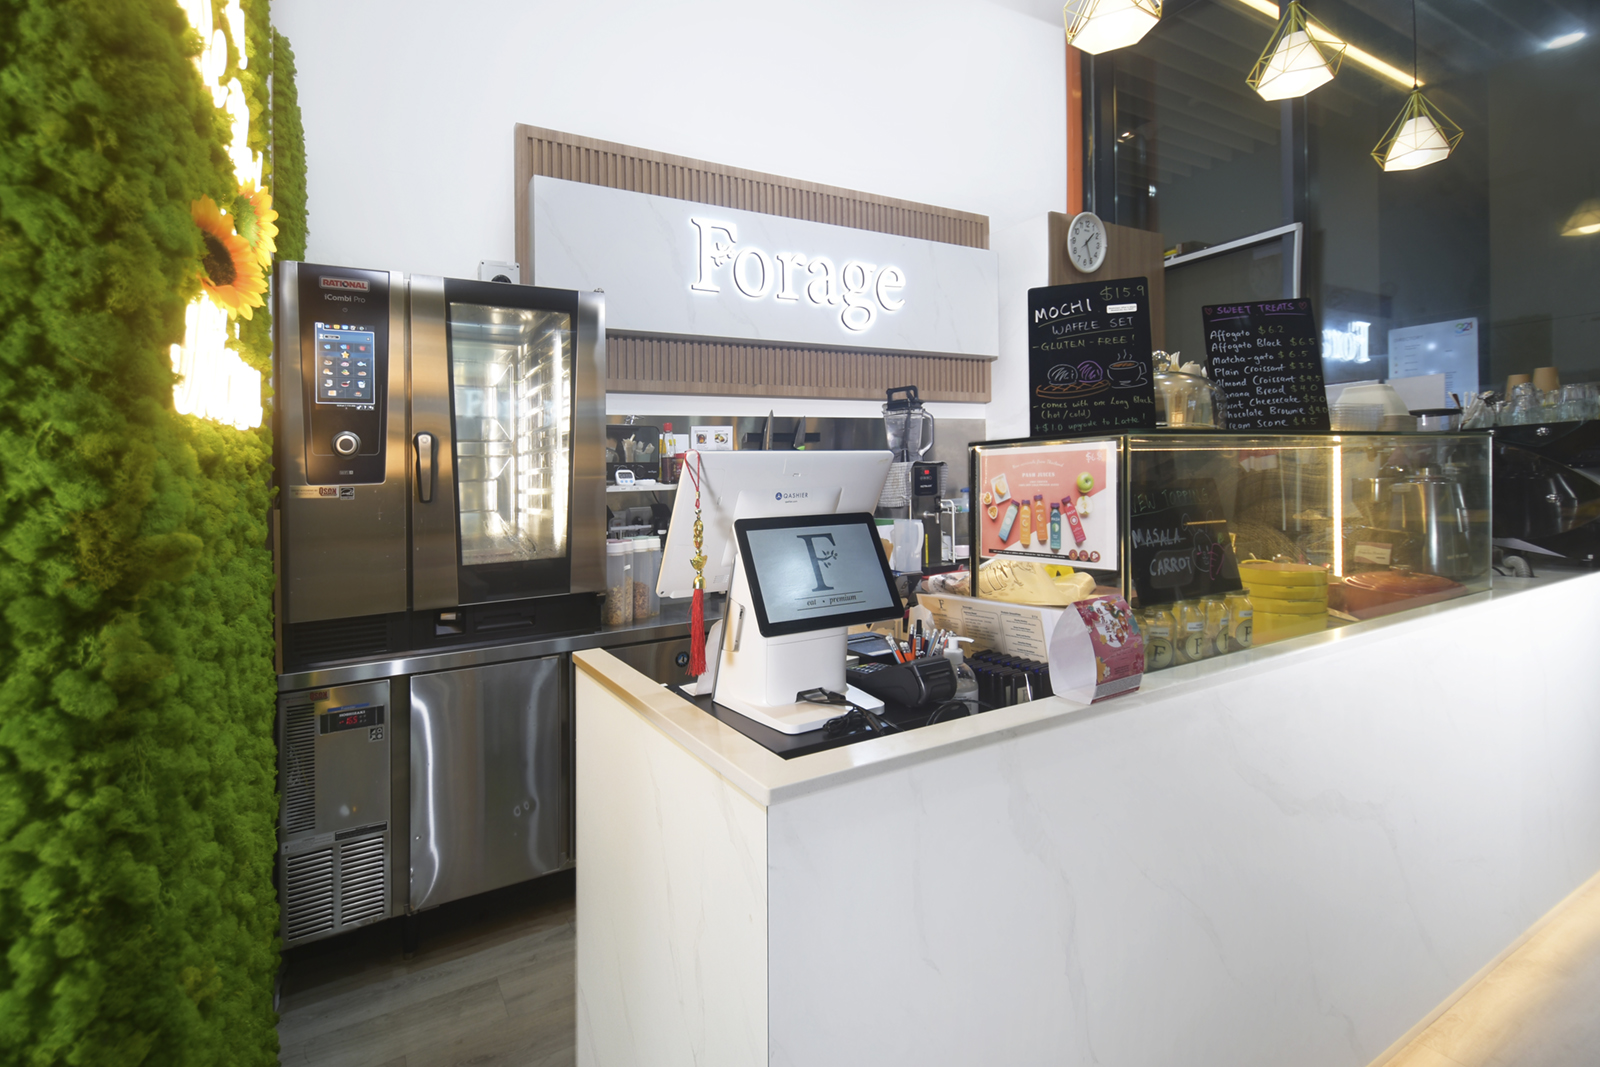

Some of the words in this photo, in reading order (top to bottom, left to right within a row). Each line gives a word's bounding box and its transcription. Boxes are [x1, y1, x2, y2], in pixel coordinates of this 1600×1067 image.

[690, 217, 906, 331] Forage
[322, 279, 367, 289] RATIONAL
[324, 294, 351, 302] iCombi
[1100, 285, 1145, 301] $15.9
[1035, 298, 1092, 323] MOCHI
[1216, 305, 1251, 315] SWEET
[1258, 302, 1295, 313] TREATS
[1052, 320, 1100, 335] WAFFLE
[1110, 316, 1133, 328] SET
[1210, 330, 1251, 342] Affogato
[1258, 325, 1284, 335] $6.2
[1212, 342, 1252, 353] Affogato
[1256, 338, 1282, 347] Black
[1289, 337, 1315, 346] $6.5
[1214, 368, 1239, 377] Plain
[1244, 364, 1286, 374] Croissant
[1215, 378, 1247, 388] Almond
[1252, 375, 1296, 385] Croissant
[1256, 385, 1286, 395] Bread
[1290, 384, 1318, 392] $4.0
[1110, 397, 1130, 409] Long
[1133, 395, 1153, 404] Black
[1249, 396, 1301, 407] Cheesecake
[1068, 420, 1097, 431] upgrade
[1257, 420, 1289, 428] Scone
[1132, 527, 1181, 549] MASALA
[796, 533, 838, 592] F
[1150, 556, 1192, 576] CARROT
[829, 594, 857, 605] premium
[1152, 645, 1166, 662] F
